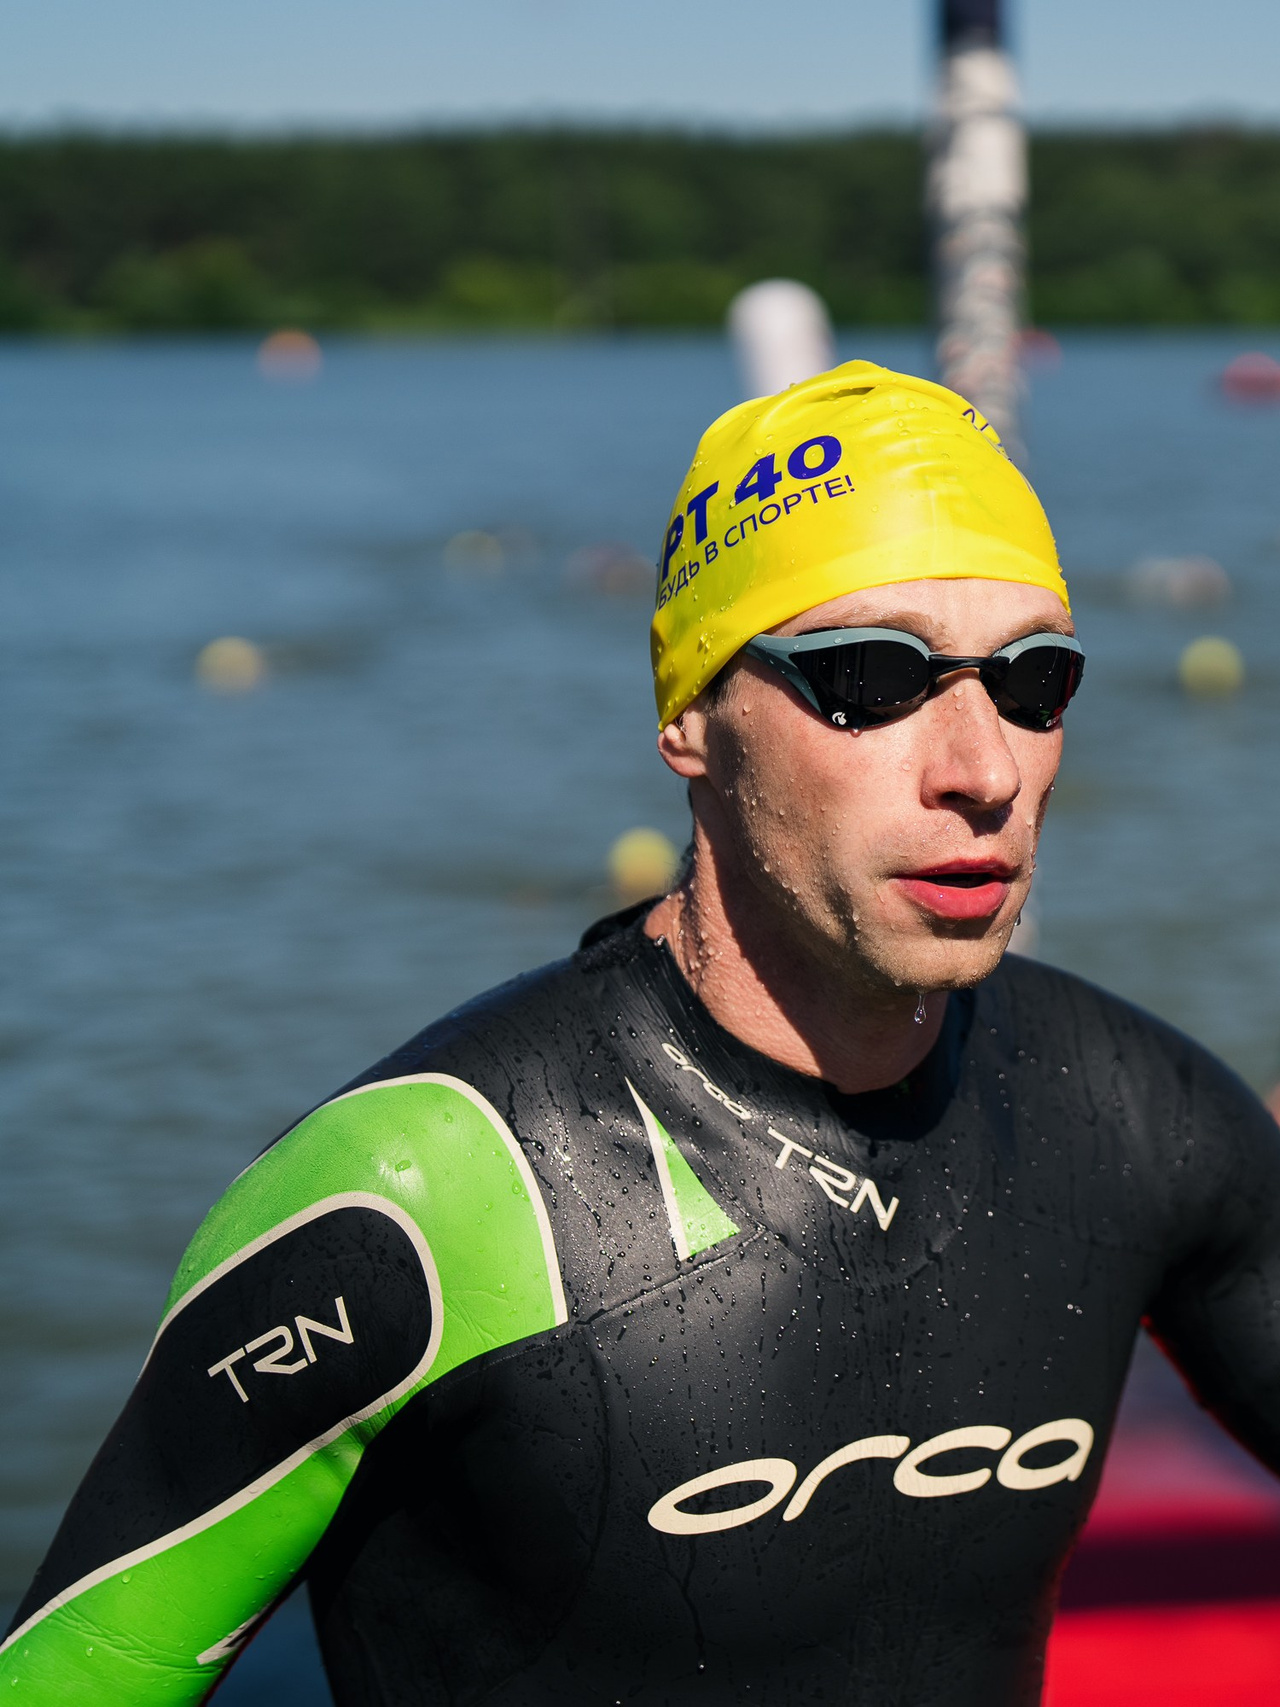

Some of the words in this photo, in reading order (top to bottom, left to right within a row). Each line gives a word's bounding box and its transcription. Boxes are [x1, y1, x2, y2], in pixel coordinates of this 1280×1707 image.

[734, 435, 842, 505] 40
[658, 560, 701, 611] БУДЬ
[704, 541, 719, 565] В
[723, 474, 856, 548] СПОРТЕ!
[662, 1042, 751, 1120] orca
[767, 1126, 900, 1231] TRN
[207, 1295, 354, 1403] TRN
[647, 1418, 1094, 1535] orca
